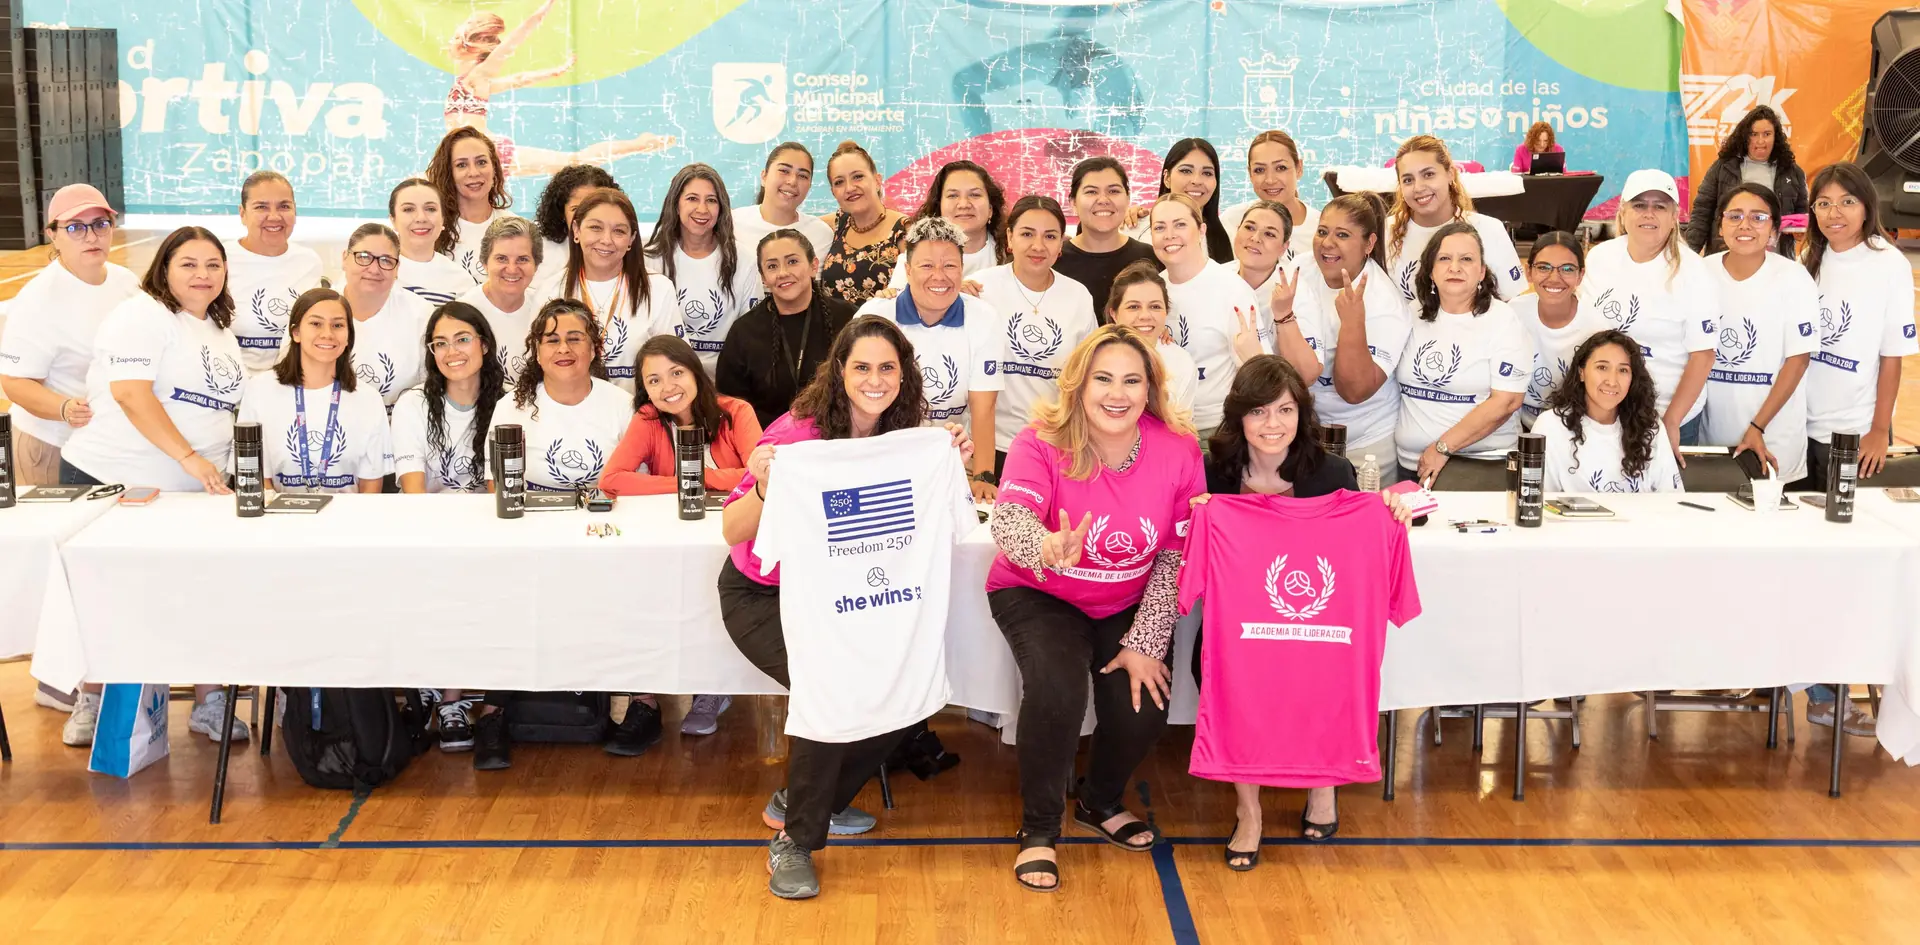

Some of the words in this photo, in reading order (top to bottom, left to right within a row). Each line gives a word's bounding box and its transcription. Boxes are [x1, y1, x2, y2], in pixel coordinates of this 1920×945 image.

[793, 71, 868, 92] Consejo
[1420, 78, 1494, 96] Ciudad
[1501, 79, 1526, 96] de
[1533, 80, 1560, 96] las
[793, 88, 884, 105] Municipal
[793, 107, 823, 122] del
[827, 107, 905, 124] Deporte
[1374, 98, 1477, 134] niñas
[1507, 97, 1608, 134] niños
[179, 142, 386, 181] Zapopan
[241, 338, 274, 347] ACADEMIA
[699, 342, 724, 350] LIDERAZ
[116, 356, 151, 366] Zapopan
[608, 368, 633, 376] LIDERAZ
[1003, 363, 1026, 374] ADEMIA
[1725, 373, 1733, 381] DE
[1734, 373, 1768, 383] LIDERAZGO
[1427, 391, 1435, 399] DE
[1008, 483, 1044, 503] Zapopan
[832, 498, 850, 507] 250
[828, 541, 884, 557] Freedom
[886, 534, 913, 551] 250
[1104, 572, 1115, 580] DE
[835, 595, 868, 614] she
[869, 588, 914, 607] wins
[1250, 626, 1290, 636] ACADEMIA
[1292, 627, 1302, 637] DE
[1304, 628, 1346, 639] LIDERAZGO
